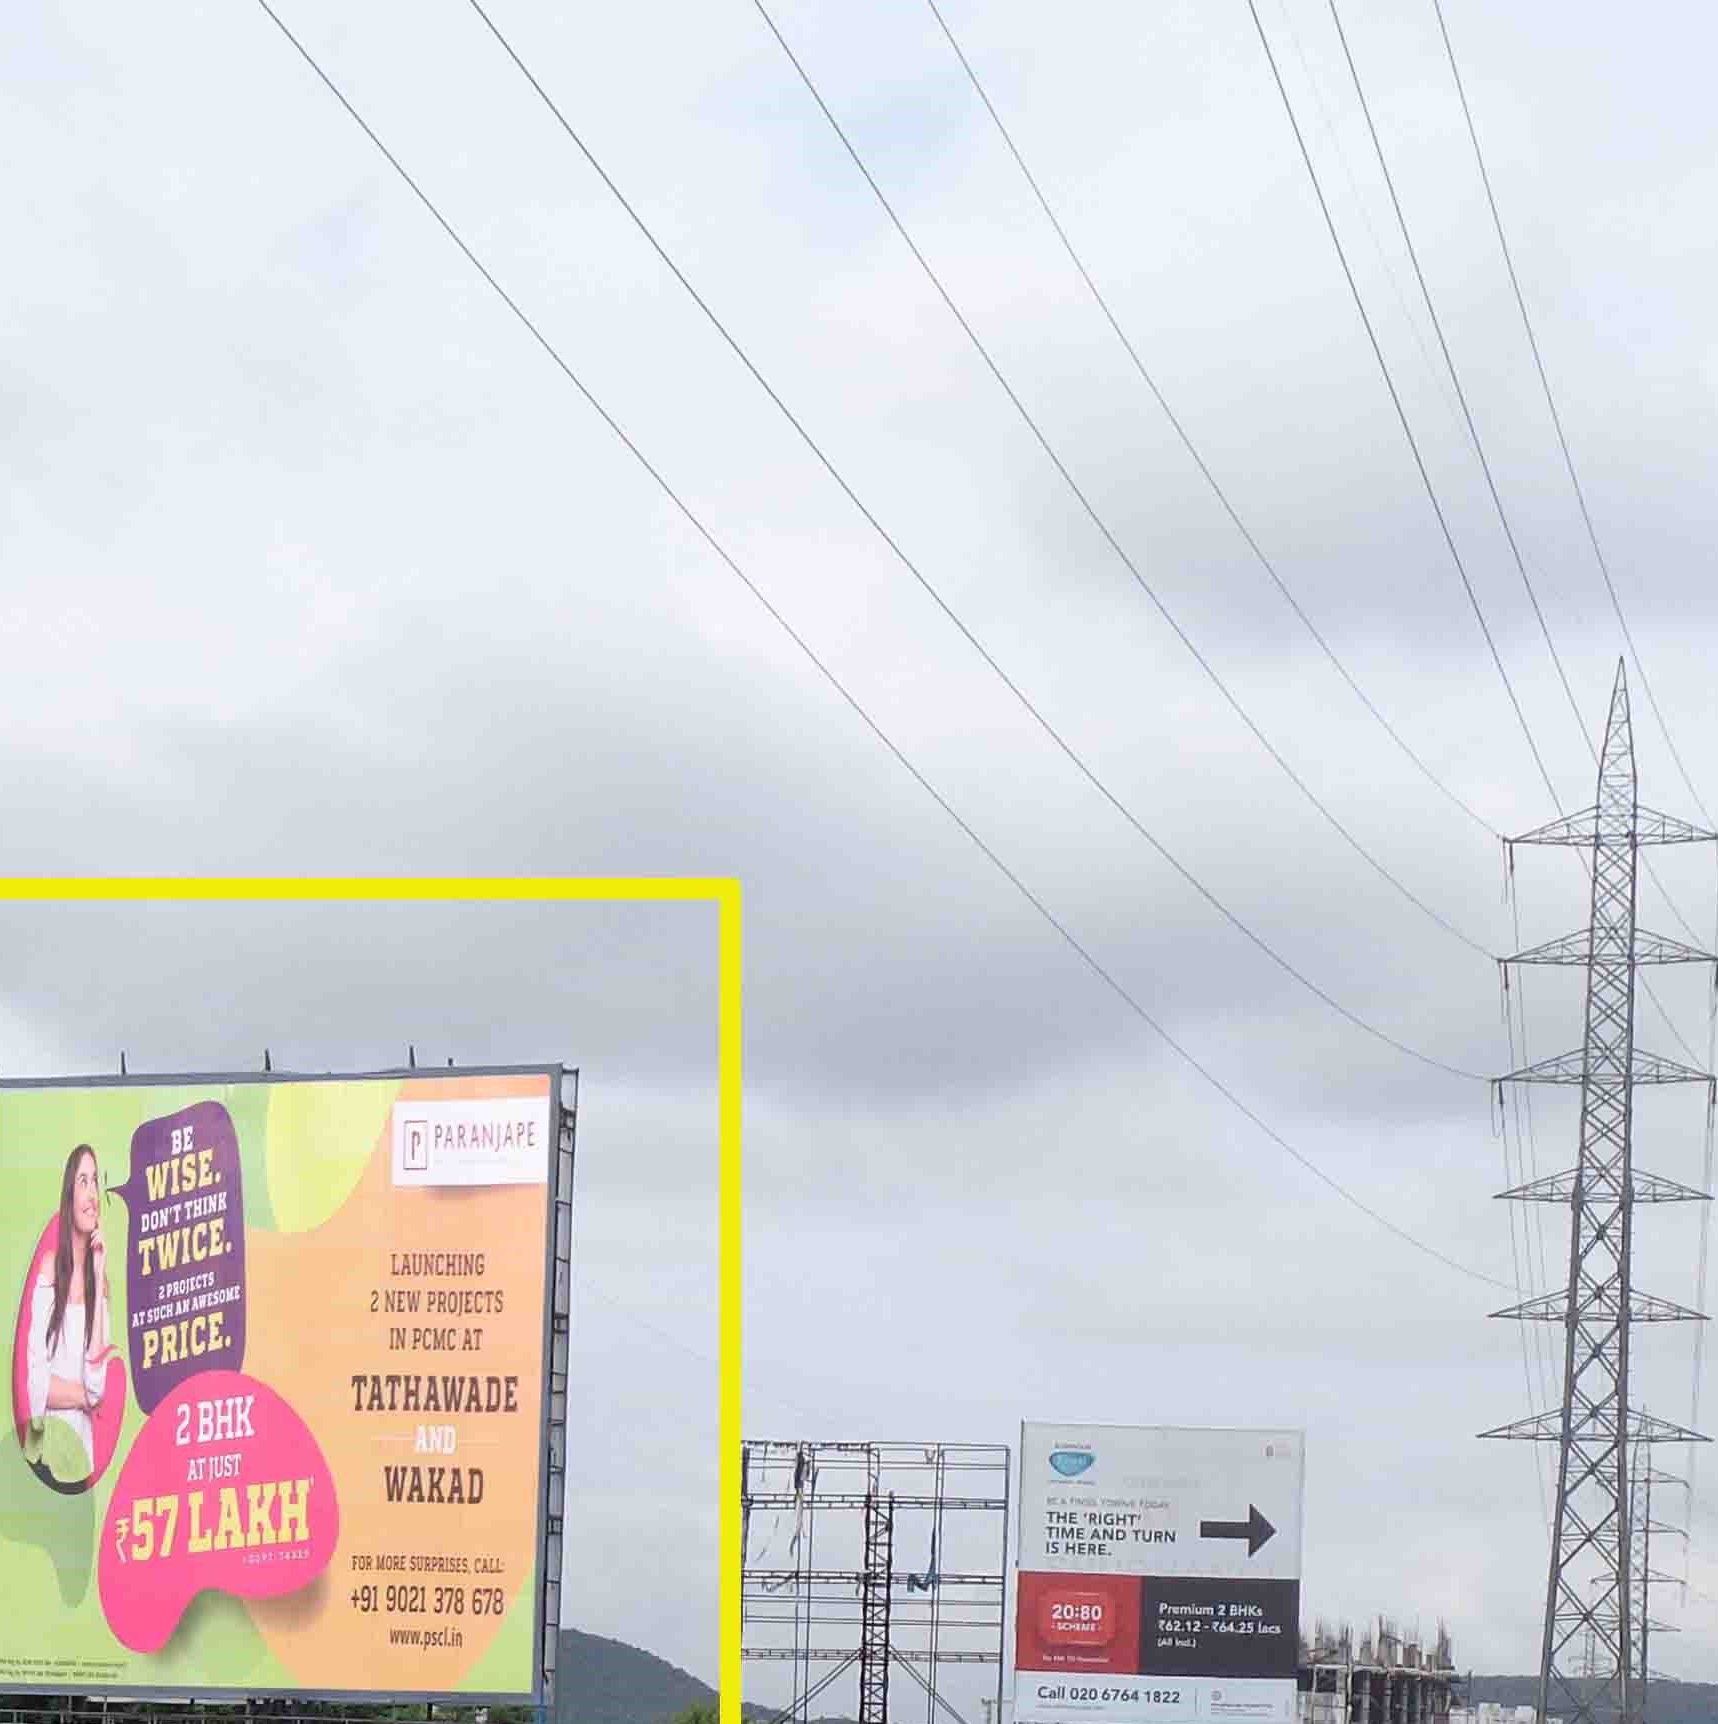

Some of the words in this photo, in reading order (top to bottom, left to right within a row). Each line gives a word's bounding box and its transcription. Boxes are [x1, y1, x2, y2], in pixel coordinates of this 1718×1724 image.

[171, 1126, 193, 1155] BE
[434, 1121, 535, 1152] PARANJAPE
[146, 1148, 221, 1202] WISE.
[141, 1204, 182, 1232] DON'T
[184, 1191, 227, 1220] THINK
[139, 1218, 232, 1276] TWICE.
[390, 1253, 485, 1276] LAUNCHING
[159, 1286, 165, 1300] 2
[167, 1272, 215, 1298] PROJECTS
[132, 1311, 146, 1328] AT
[147, 1303, 174, 1323] SUCH
[175, 1298, 190, 1315] AN
[191, 1285, 241, 1311] AWESOME
[370, 1290, 380, 1313] 2
[384, 1290, 421, 1313] NEW
[427, 1290, 504, 1317] PROJECTS
[142, 1311, 232, 1369] PRICE.
[389, 1327, 406, 1350] IN
[412, 1328, 457, 1351] PCMC
[462, 1328, 484, 1351] AT
[351, 1374, 519, 1413] TATHAWADE
[175, 1403, 191, 1446] 2
[196, 1395, 256, 1443] BHK
[415, 1424, 457, 1455] AND
[187, 1457, 206, 1481] AT
[209, 1453, 242, 1483] JUST
[384, 1466, 484, 1504] WAKAD
[1046, 1511, 1078, 1524] THE
[1046, 1526, 1085, 1540] TIME
[1090, 1527, 1126, 1541] AND
[1132, 1529, 1176, 1543] TURN
[1046, 1541, 1060, 1554] IS
[1065, 1542, 1112, 1556] HERE.
[351, 1555, 372, 1571] FOR
[376, 1555, 406, 1572] MORE
[351, 1585, 379, 1613] +91
[386, 1585, 426, 1613] 9021
[434, 1587, 465, 1615] 378
[472, 1588, 505, 1615] 678
[1051, 1604, 1102, 1620] 20:80
[1158, 1602, 1214, 1616] Premium
[1217, 1604, 1226, 1616] 2
[389, 1626, 463, 1651] www.pscl.in
[1037, 1685, 1066, 1700] Call
[1070, 1687, 1098, 1701] 020
[1101, 1687, 1140, 1702] 6764
[1144, 1690, 1181, 1704] 1822
